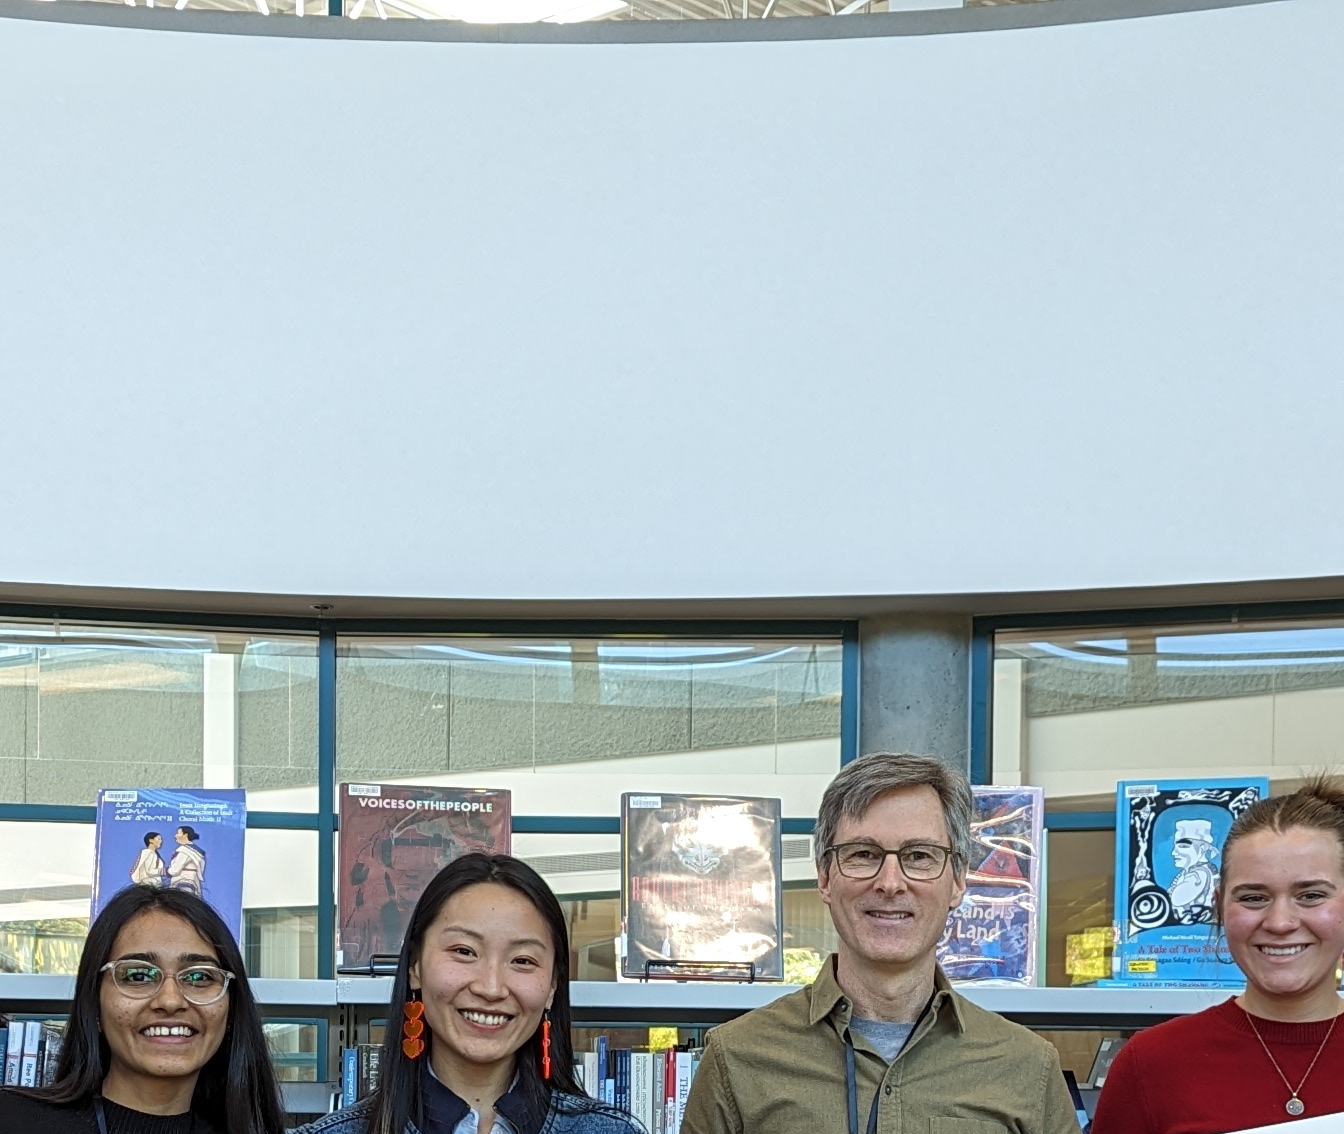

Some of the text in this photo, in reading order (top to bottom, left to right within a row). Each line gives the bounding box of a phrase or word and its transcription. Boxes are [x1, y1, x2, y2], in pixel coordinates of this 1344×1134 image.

[358, 797, 493, 813] VOICESOFTHEPEOPLE
[957, 920, 1000, 941] Land
[679, 1077, 689, 1099] THE
